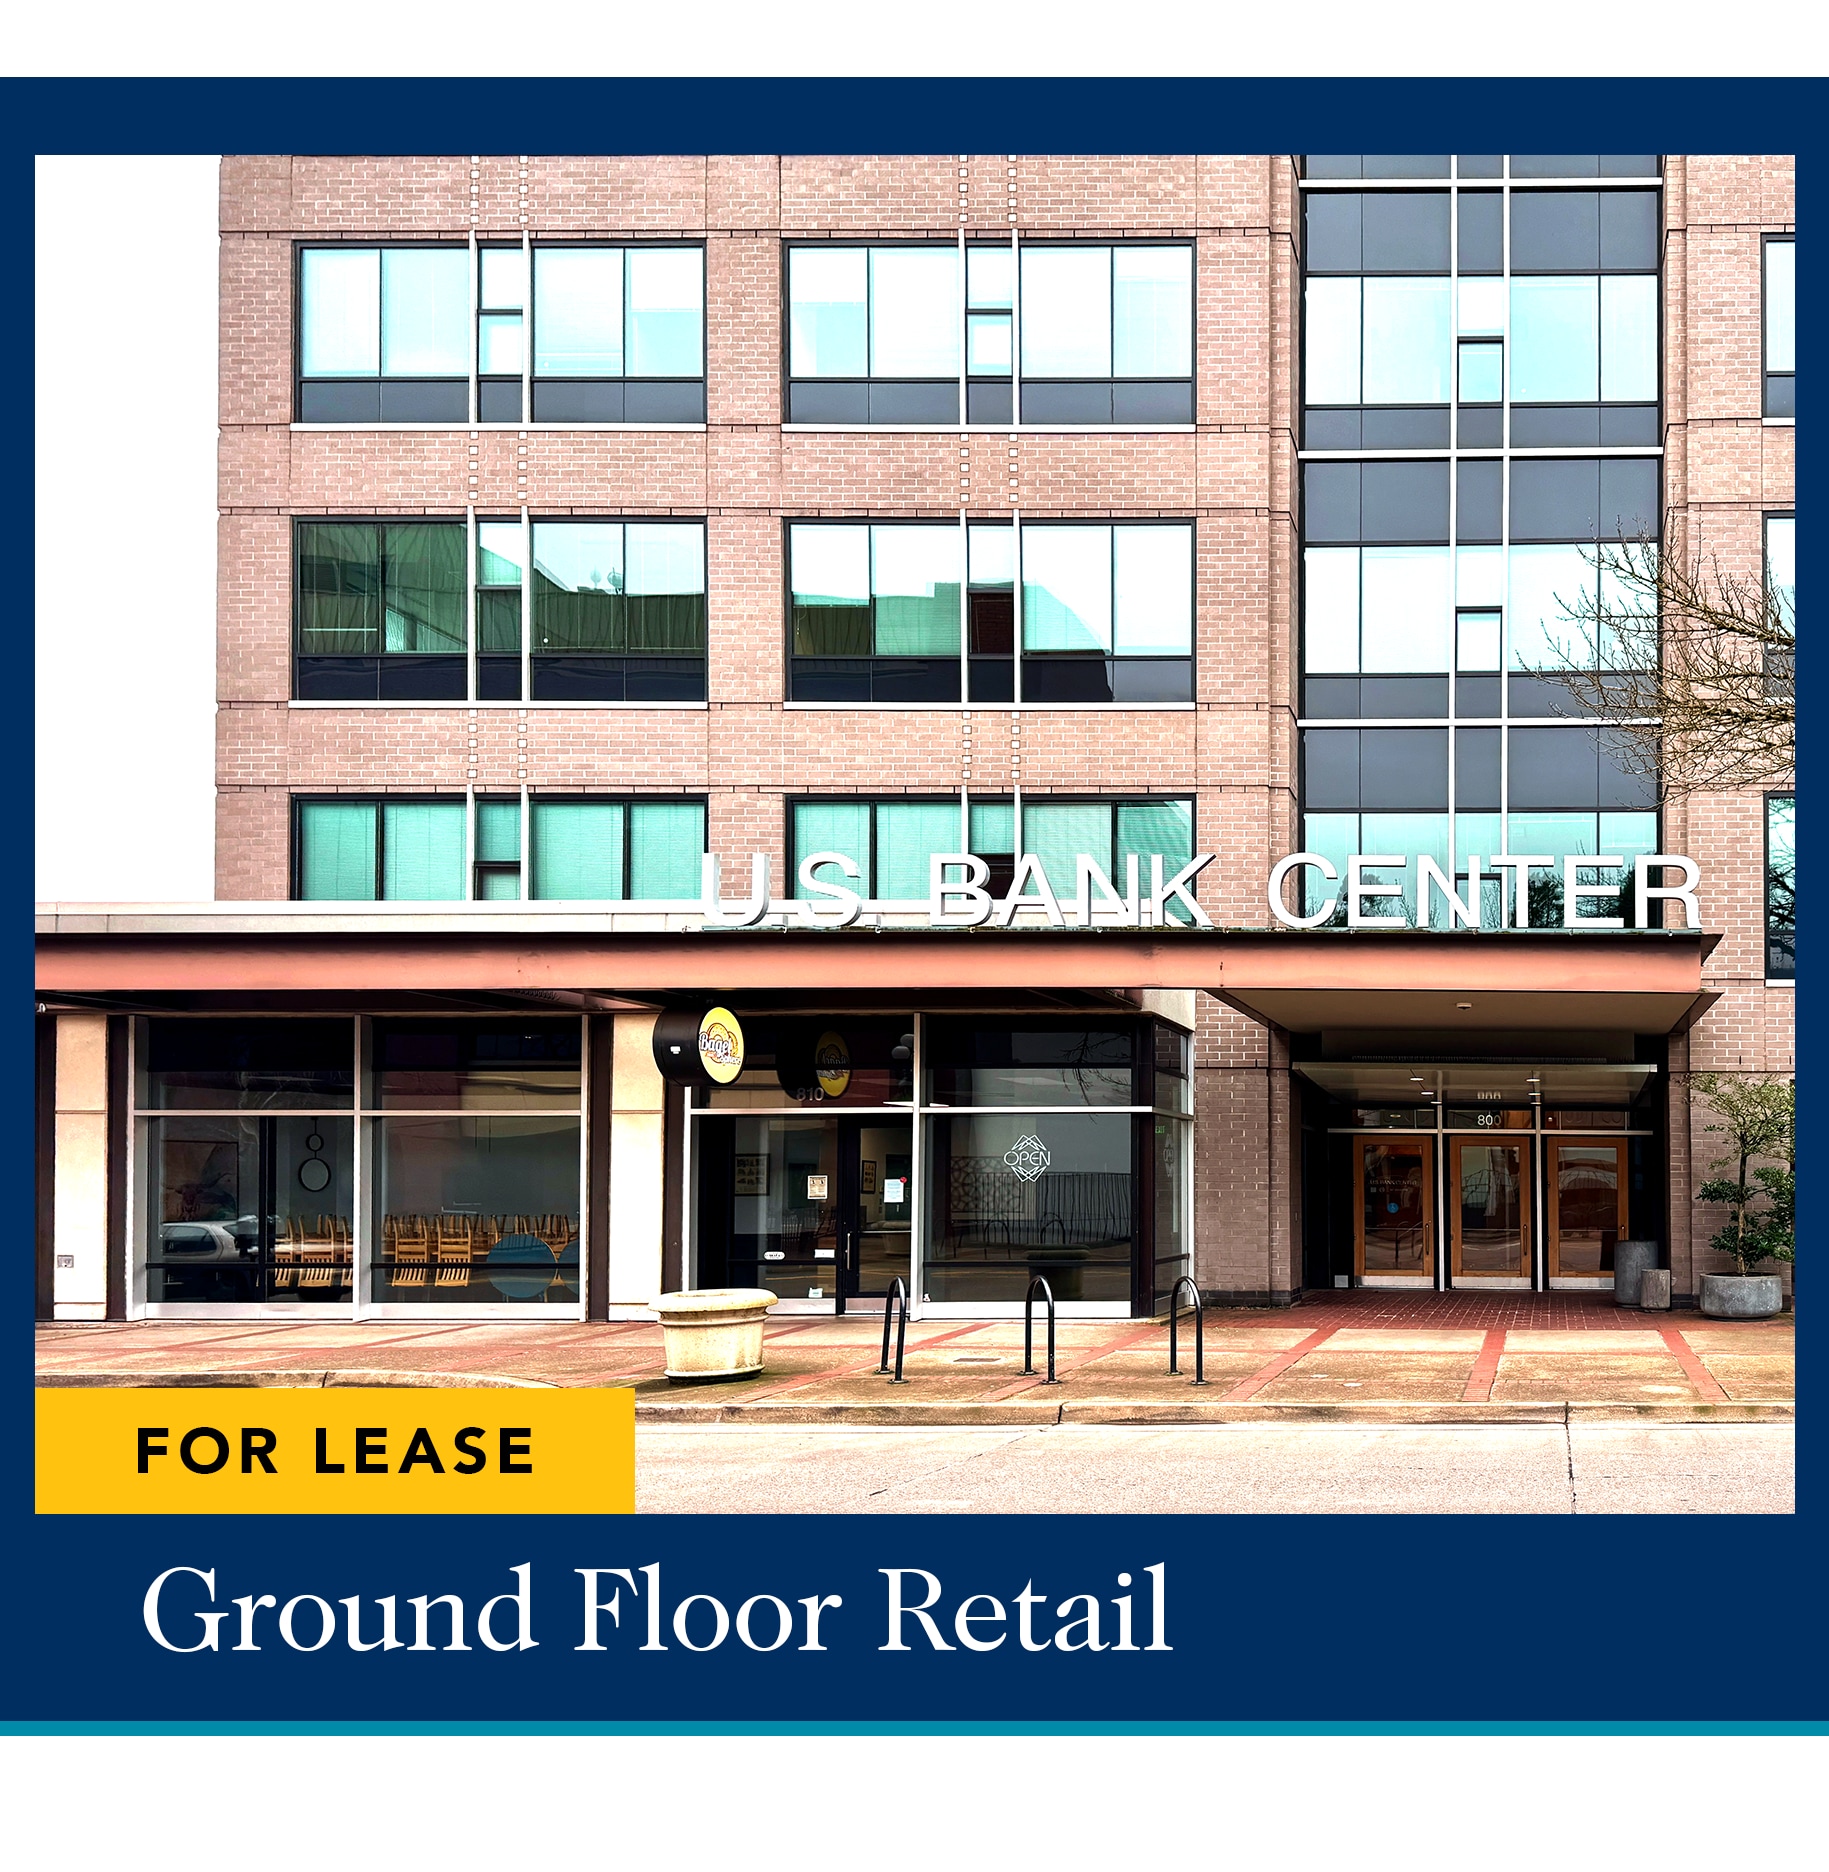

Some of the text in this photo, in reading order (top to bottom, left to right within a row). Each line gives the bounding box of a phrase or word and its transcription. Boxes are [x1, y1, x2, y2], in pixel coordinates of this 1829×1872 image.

[701, 851, 1702, 929] U.S. BANK CENTER
[699, 1031, 732, 1058] Bagel
[796, 1087, 825, 1101] 810
[1477, 1114, 1502, 1126] 800
[1003, 1150, 1051, 1166] OPEN
